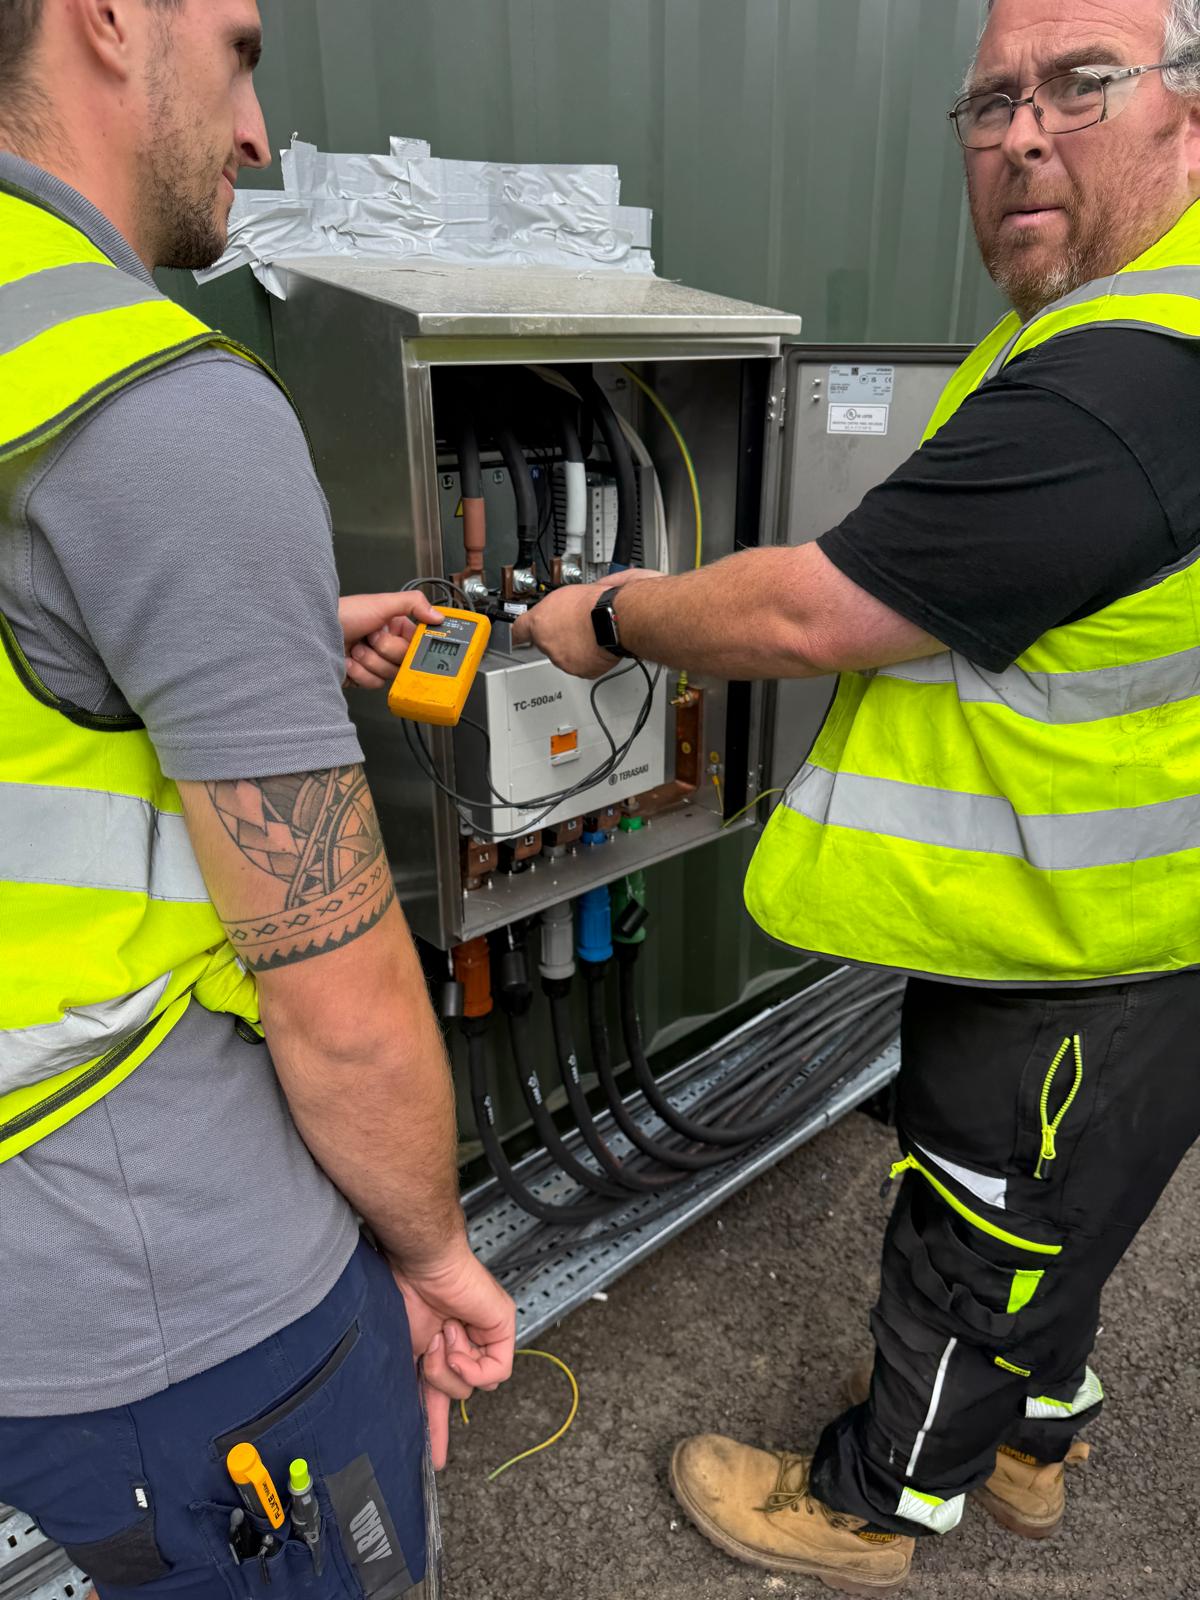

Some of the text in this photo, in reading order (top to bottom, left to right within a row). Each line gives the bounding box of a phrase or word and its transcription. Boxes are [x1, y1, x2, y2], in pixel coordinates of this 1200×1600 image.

[513, 691, 563, 712] TC-500a/4
[619, 763, 649, 782] TERASAKI
[524, 835, 535, 846] L2
[479, 852, 489, 862] L1
[267, 1494, 280, 1519] FLUKE
